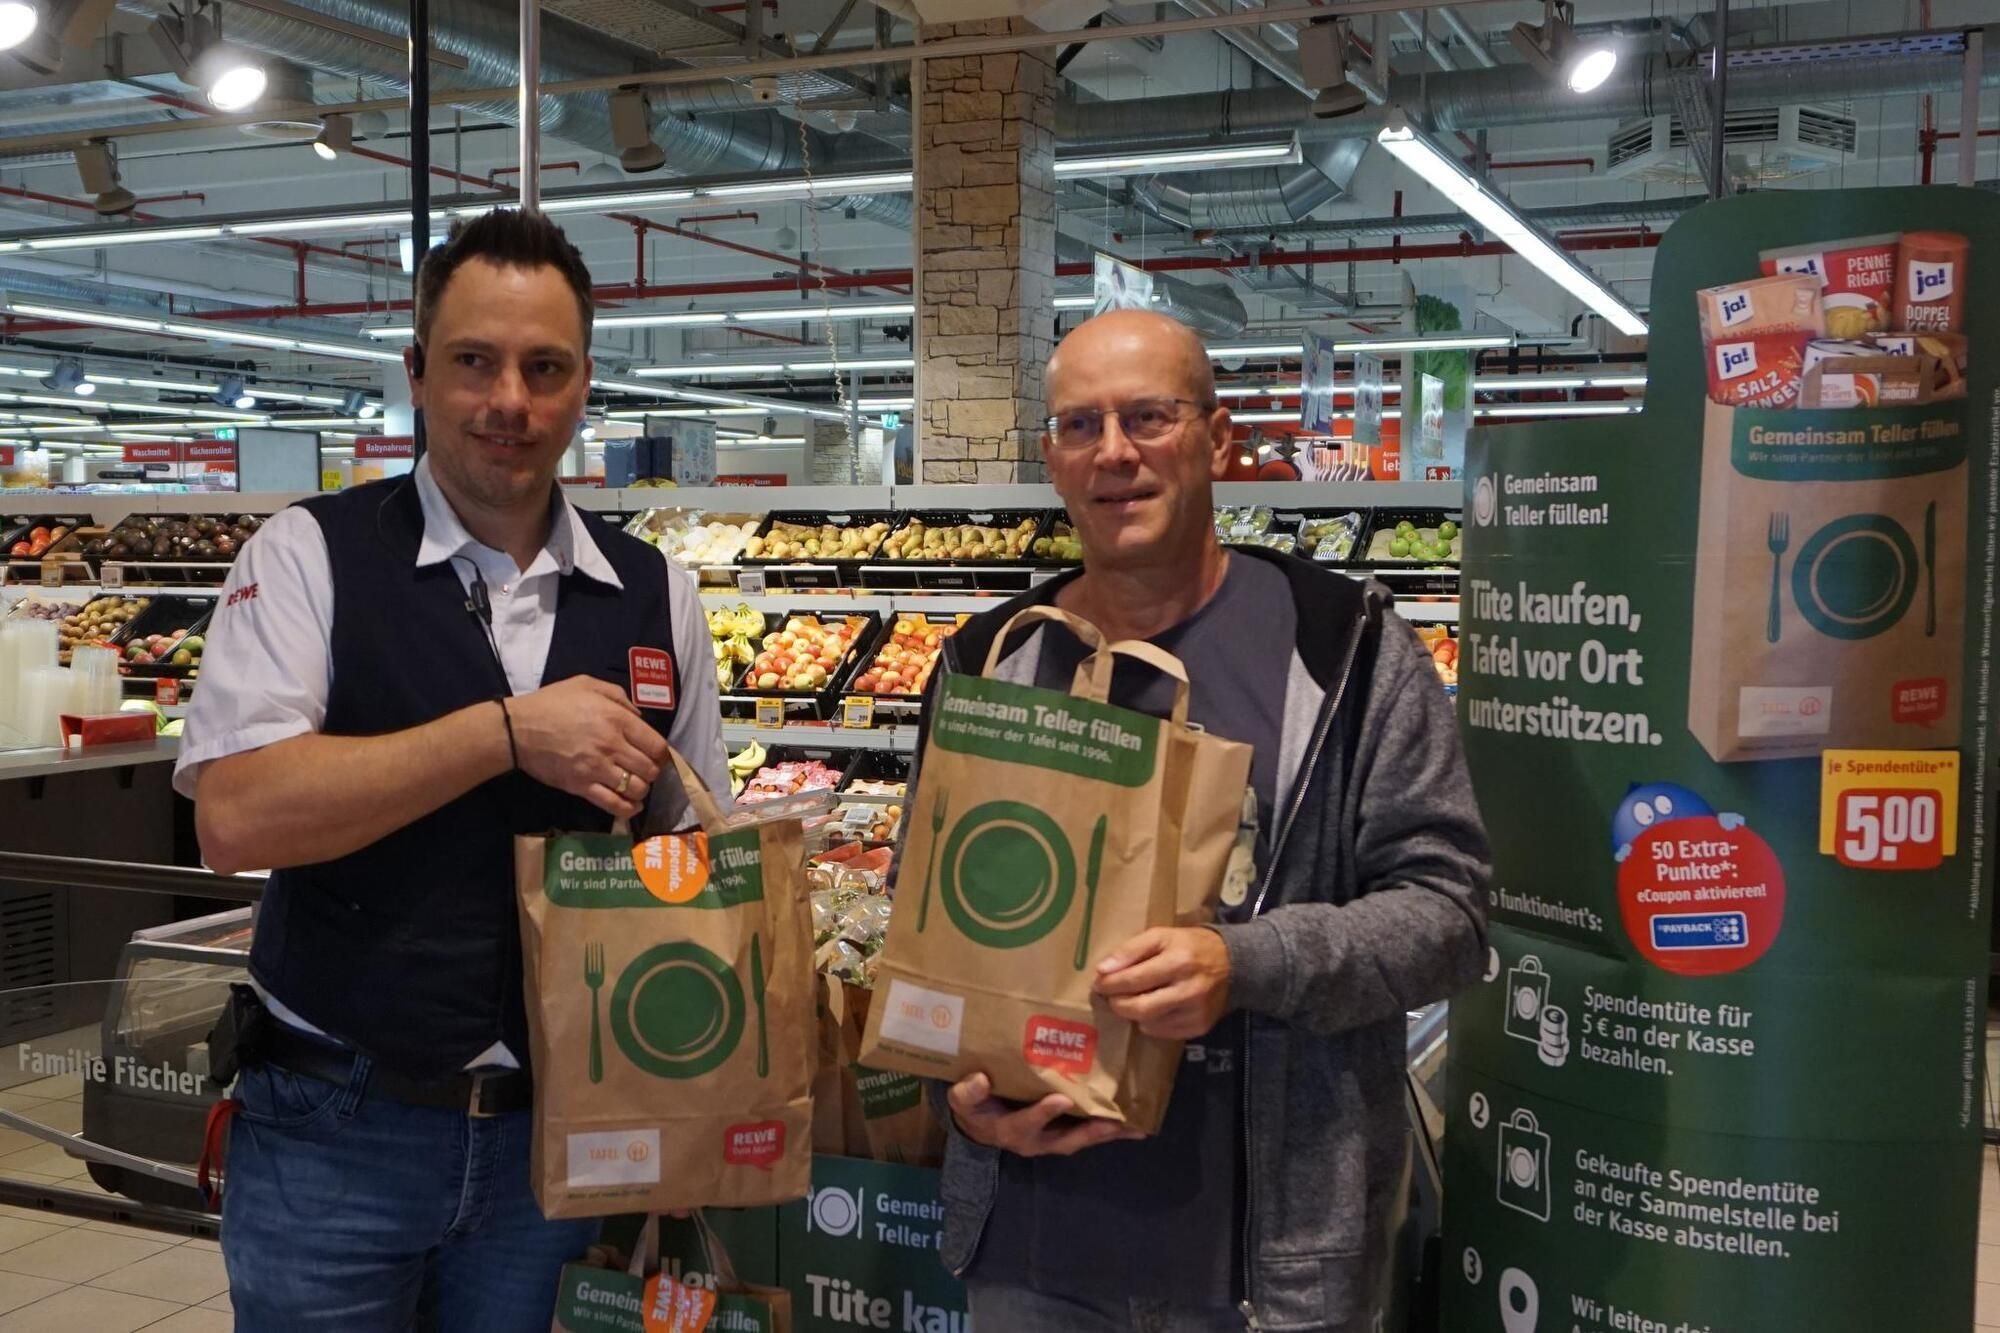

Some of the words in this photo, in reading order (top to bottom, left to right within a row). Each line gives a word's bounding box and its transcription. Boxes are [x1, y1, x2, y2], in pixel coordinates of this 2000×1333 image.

[1848, 254, 1891, 272] PENNE
[1847, 269, 1893, 288] RIGATE
[1916, 268, 1946, 295] ja!
[1722, 296, 1748, 321] ja!
[1905, 304, 1950, 321] DOPPEL
[1722, 347, 1750, 373] ja!
[1737, 370, 1781, 399] SALZ
[1750, 425, 1865, 446] Gemeinsam
[1870, 424, 1918, 443] Teller
[1920, 420, 1959, 439] füllen
[131, 447, 171, 457] Waschmittel
[190, 446, 232, 456] Küchenrollen
[365, 443, 412, 454] Babynahrung
[1504, 472, 1598, 494] Gemeinsam
[1989, 468, 2000, 513] passende
[1504, 505, 1546, 526] Teller
[1549, 503, 1609, 525] füllen!
[226, 582, 258, 608] REWE
[1470, 579, 1513, 622] Tüte
[1519, 581, 1642, 632] kaufen,
[634, 656, 667, 671] REWE
[1470, 633, 1519, 678] Tafel
[1524, 650, 1572, 681] vor
[1579, 639, 1643, 685] Ort
[1900, 686, 1939, 702] REWE
[1033, 704, 1088, 736] Teller
[1089, 717, 1142, 752] füllen
[1469, 696, 1662, 746] unterstützen.
[948, 720, 968, 734] sind
[1003, 728, 1025, 743] der
[1028, 732, 1057, 749] Tafel
[1058, 740, 1081, 755] seit
[1828, 759, 1841, 776] je
[1844, 795, 1936, 861] 5.00
[560, 851, 637, 871] Gemein
[1651, 841, 1674, 860] 50
[1679, 839, 1739, 859] Extra-
[560, 878, 580, 890] Wir
[583, 877, 607, 890] sind
[1637, 888, 1691, 904] eCoupon
[1694, 884, 1767, 901] aktivieren!
[1500, 887, 1603, 932] funktioniert's:
[1663, 923, 1712, 933] PAYBACK
[1584, 986, 1711, 1025] Spendentüte
[1718, 1004, 1752, 1028] für
[1035, 1026, 1087, 1049] REWE
[1581, 1014, 1592, 1034] 5
[1597, 1018, 1609, 1037] €
[1614, 1025, 1637, 1043] an
[1643, 1025, 1681, 1049] der
[1687, 1030, 1754, 1056] Kasse
[18, 1043, 107, 1083] Familie
[114, 1056, 207, 1096] Fischer
[1581, 1038, 1673, 1076] bezahlen.
[734, 1128, 777, 1145] REWE
[1575, 1149, 1662, 1188] Gekaufte
[1668, 1170, 1820, 1204] Spendentüte
[1574, 1179, 1596, 1198] an
[1601, 1181, 1634, 1208] der
[1640, 1191, 1796, 1231] Sammelstelle
[1803, 1210, 1840, 1232] bei
[876, 1222, 930, 1248] Teller
[1573, 1202, 1604, 1226] der
[1609, 1210, 1669, 1243] Kasse
[1675, 1226, 1791, 1259] abstellen.
[576, 1281, 643, 1314] Gemein
[805, 1273, 892, 1330] Tüte
[573, 1306, 590, 1319] Wir
[594, 1312, 614, 1325] sind
[616, 1316, 644, 1332] Partn
[1571, 1294, 1603, 1318] Wir
[1609, 1305, 1667, 1333] leiten
